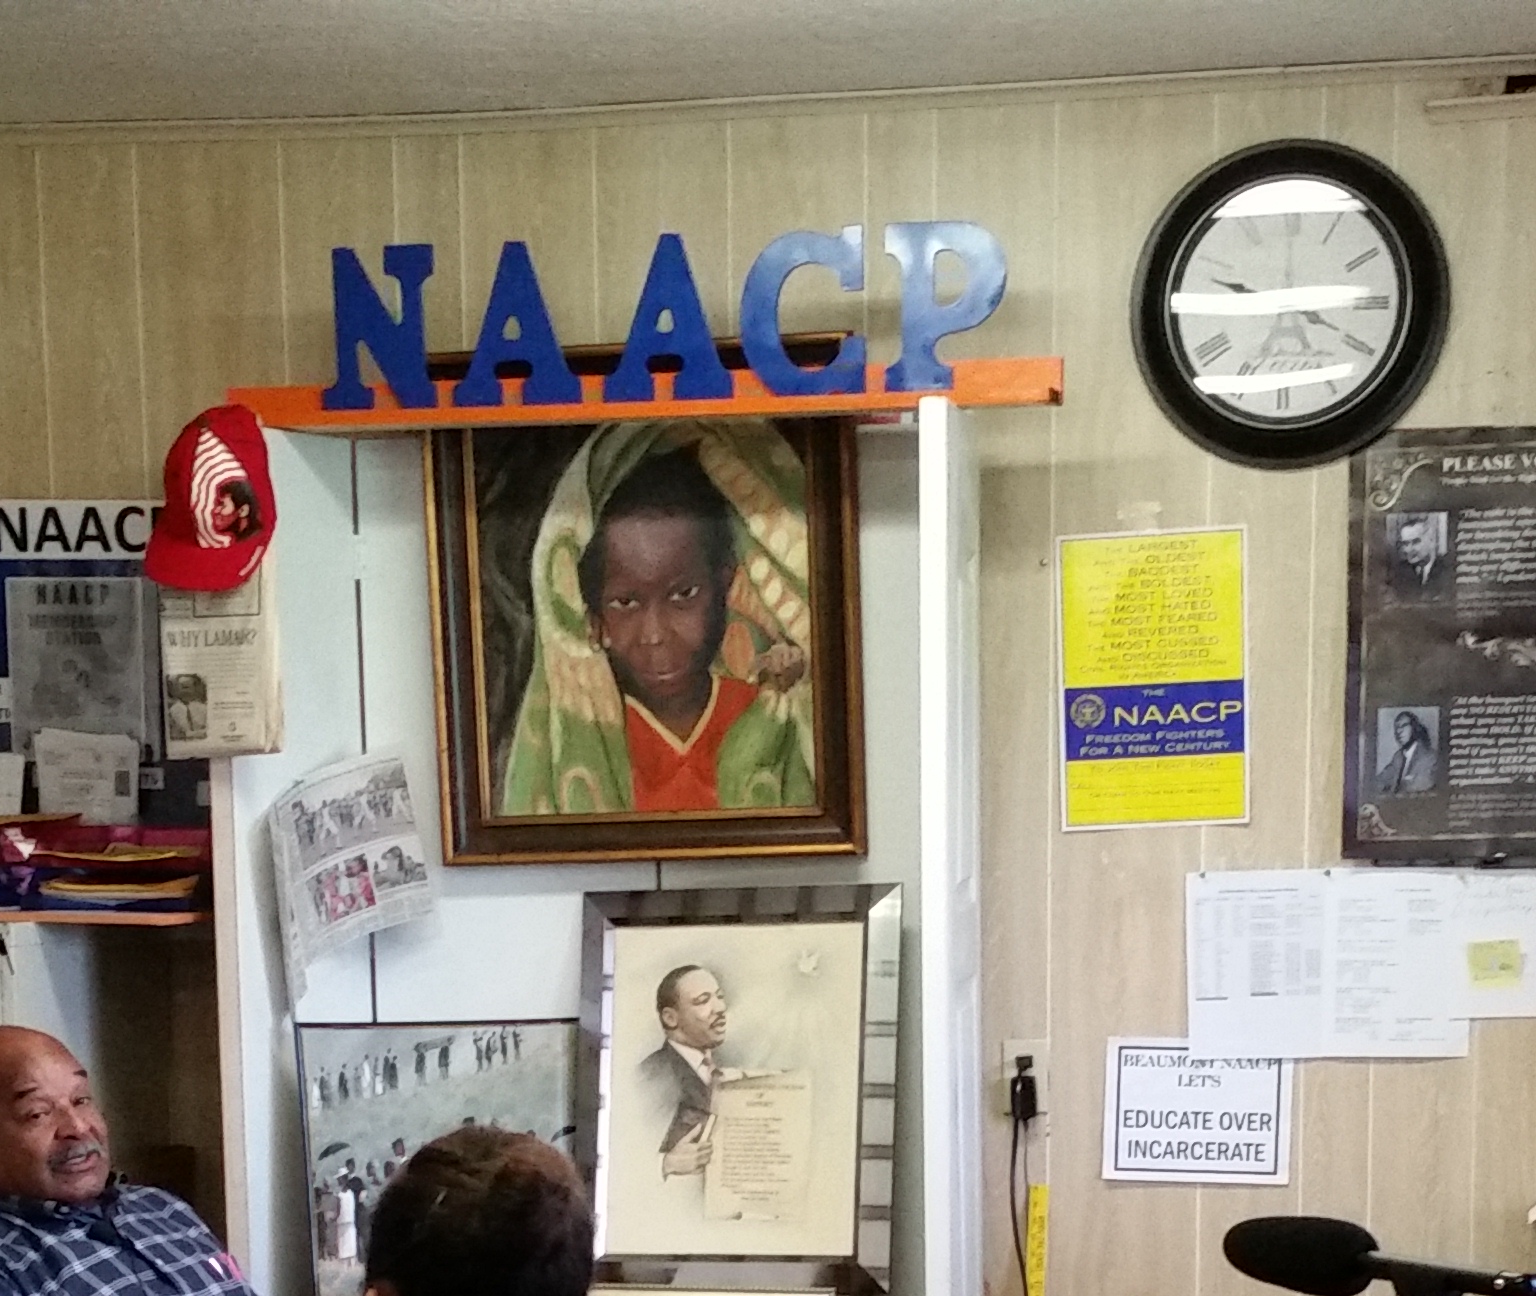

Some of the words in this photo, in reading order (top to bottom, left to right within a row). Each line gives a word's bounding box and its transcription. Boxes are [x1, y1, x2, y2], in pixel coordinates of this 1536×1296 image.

[321, 221, 1008, 411] NAACP
[1442, 455, 1515, 473] PLEASE
[1115, 591, 1155, 602] MOST
[1163, 588, 1213, 600] LOVED
[1115, 603, 1155, 614] MOST
[1111, 615, 1152, 626] MOST
[1111, 640, 1151, 649] MOST
[1114, 701, 1242, 727] NAACP
[1086, 732, 1152, 744] FREEDOM
[1080, 747, 1108, 757] FOR
[1128, 744, 1161, 754] NEW
[1123, 1109, 1214, 1131] EDUCATE
[1219, 1111, 1272, 1132] OVER
[1127, 1139, 1267, 1163] INCARCERATE
